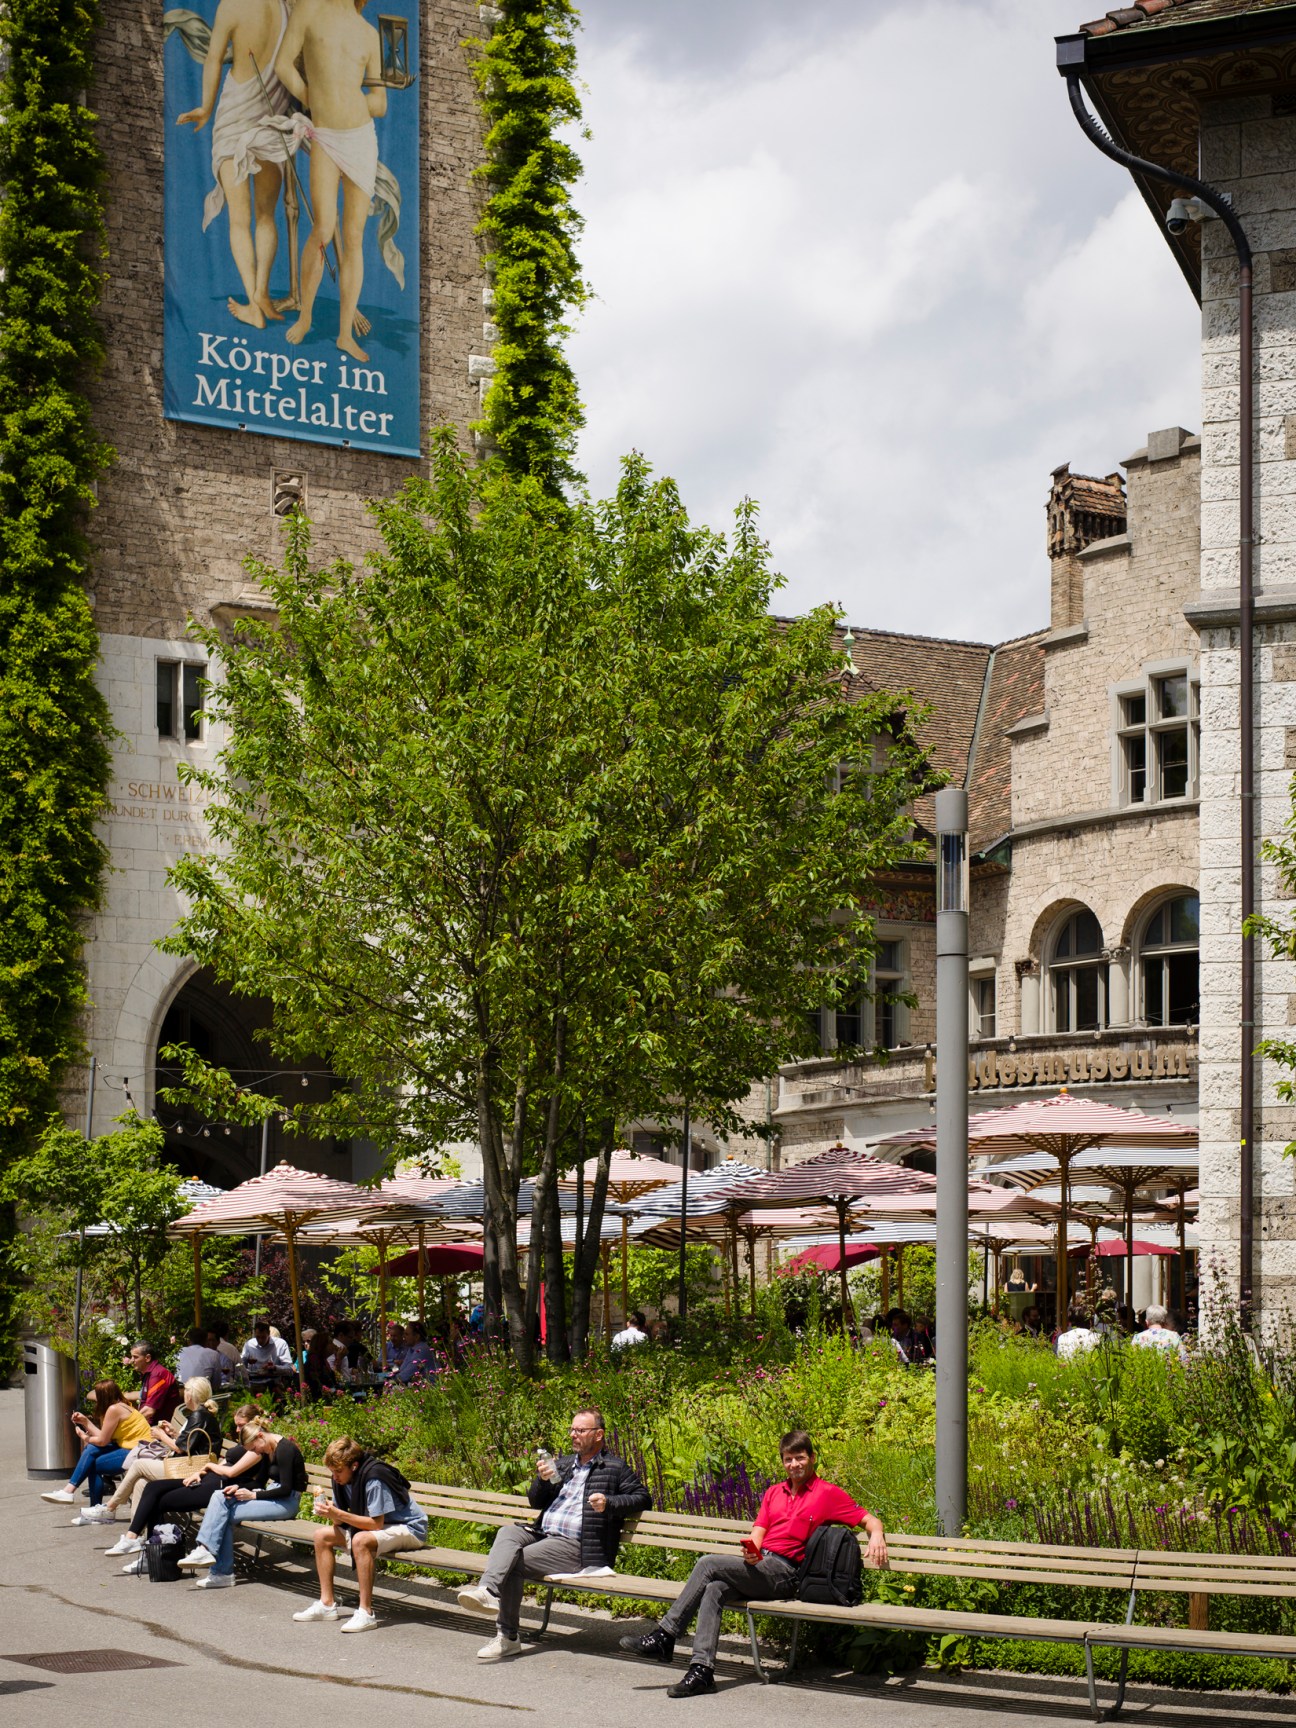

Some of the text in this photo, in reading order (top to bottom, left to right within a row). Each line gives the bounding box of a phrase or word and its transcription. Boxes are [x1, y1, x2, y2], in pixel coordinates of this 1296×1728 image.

[198, 332, 388, 396] Körper im
[192, 374, 394, 437] Mittelalter
